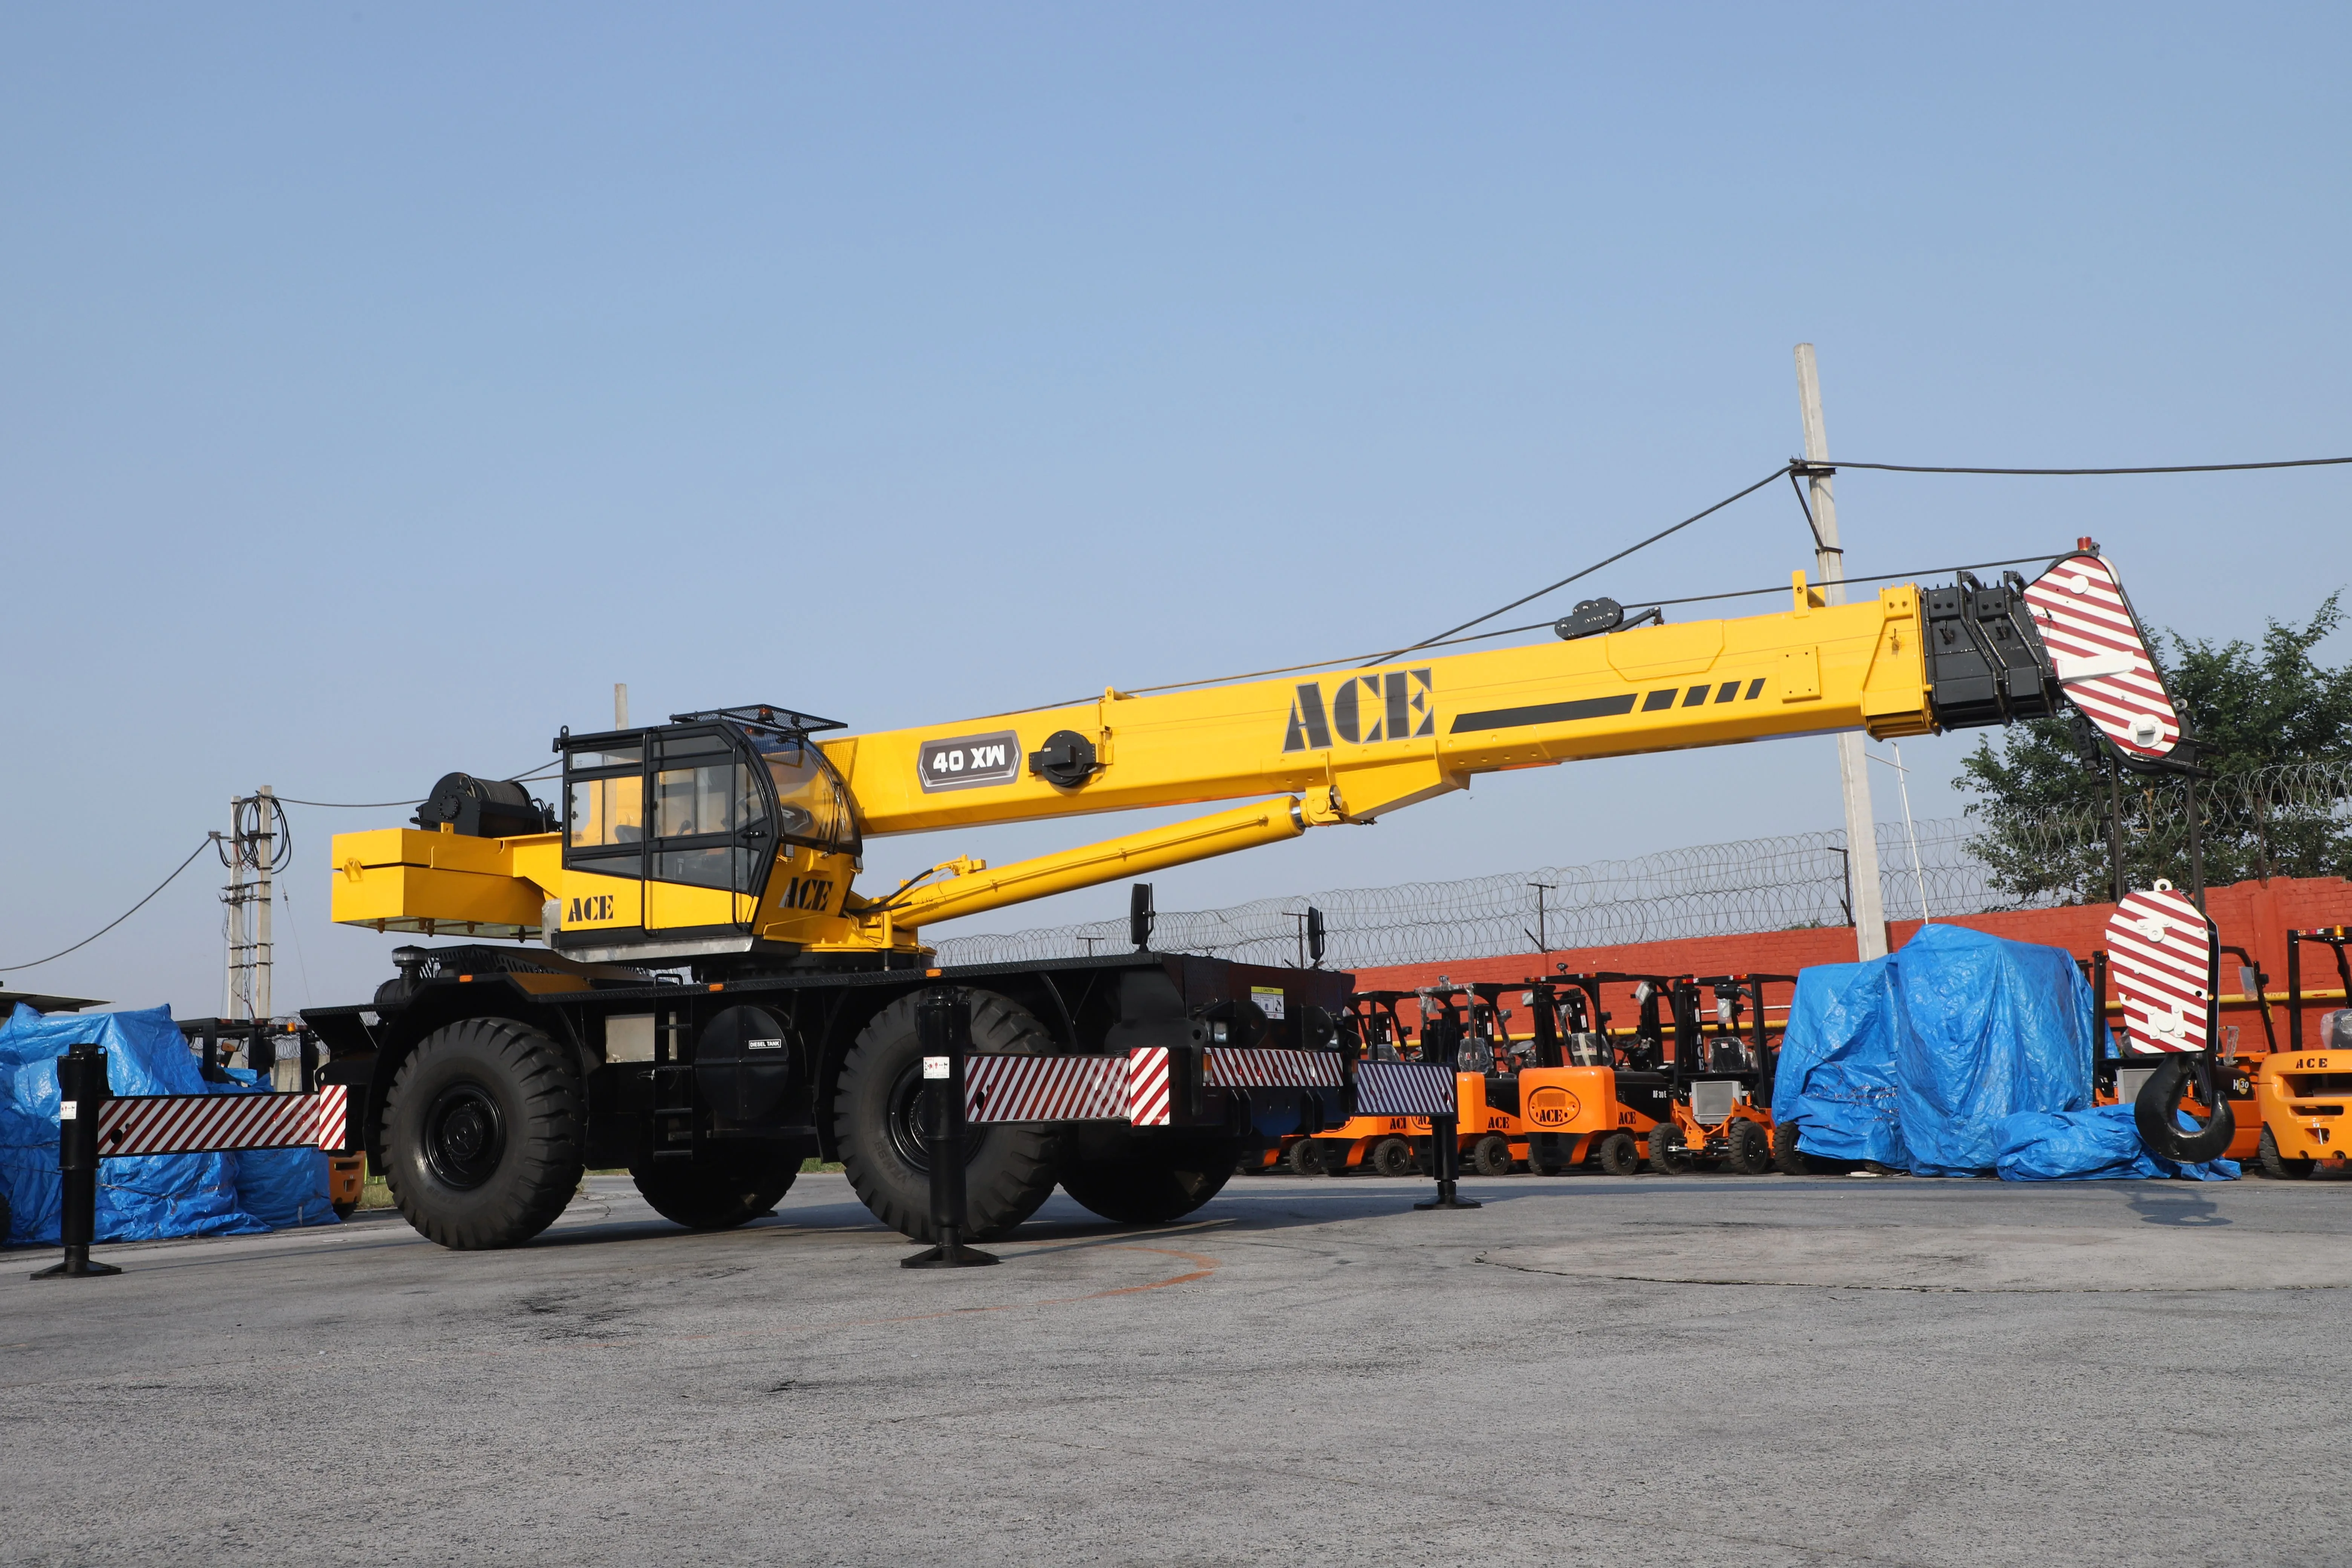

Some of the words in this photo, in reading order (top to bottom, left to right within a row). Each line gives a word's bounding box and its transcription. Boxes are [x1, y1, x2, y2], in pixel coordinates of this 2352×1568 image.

[1282, 667, 1435, 753] ACE
[933, 750, 964, 773] 40
[970, 744, 1005, 769] XW
[778, 877, 833, 911] ACE
[567, 895, 613, 922] ACE
[1697, 1033, 1705, 1070] ACE
[2295, 1058, 2328, 1069] ACE
[1418, 1116, 1430, 1125] AC
[1488, 1116, 1510, 1129] ACE
[1539, 1109, 1563, 1122] ACE
[1618, 1112, 1636, 1124] ACE
